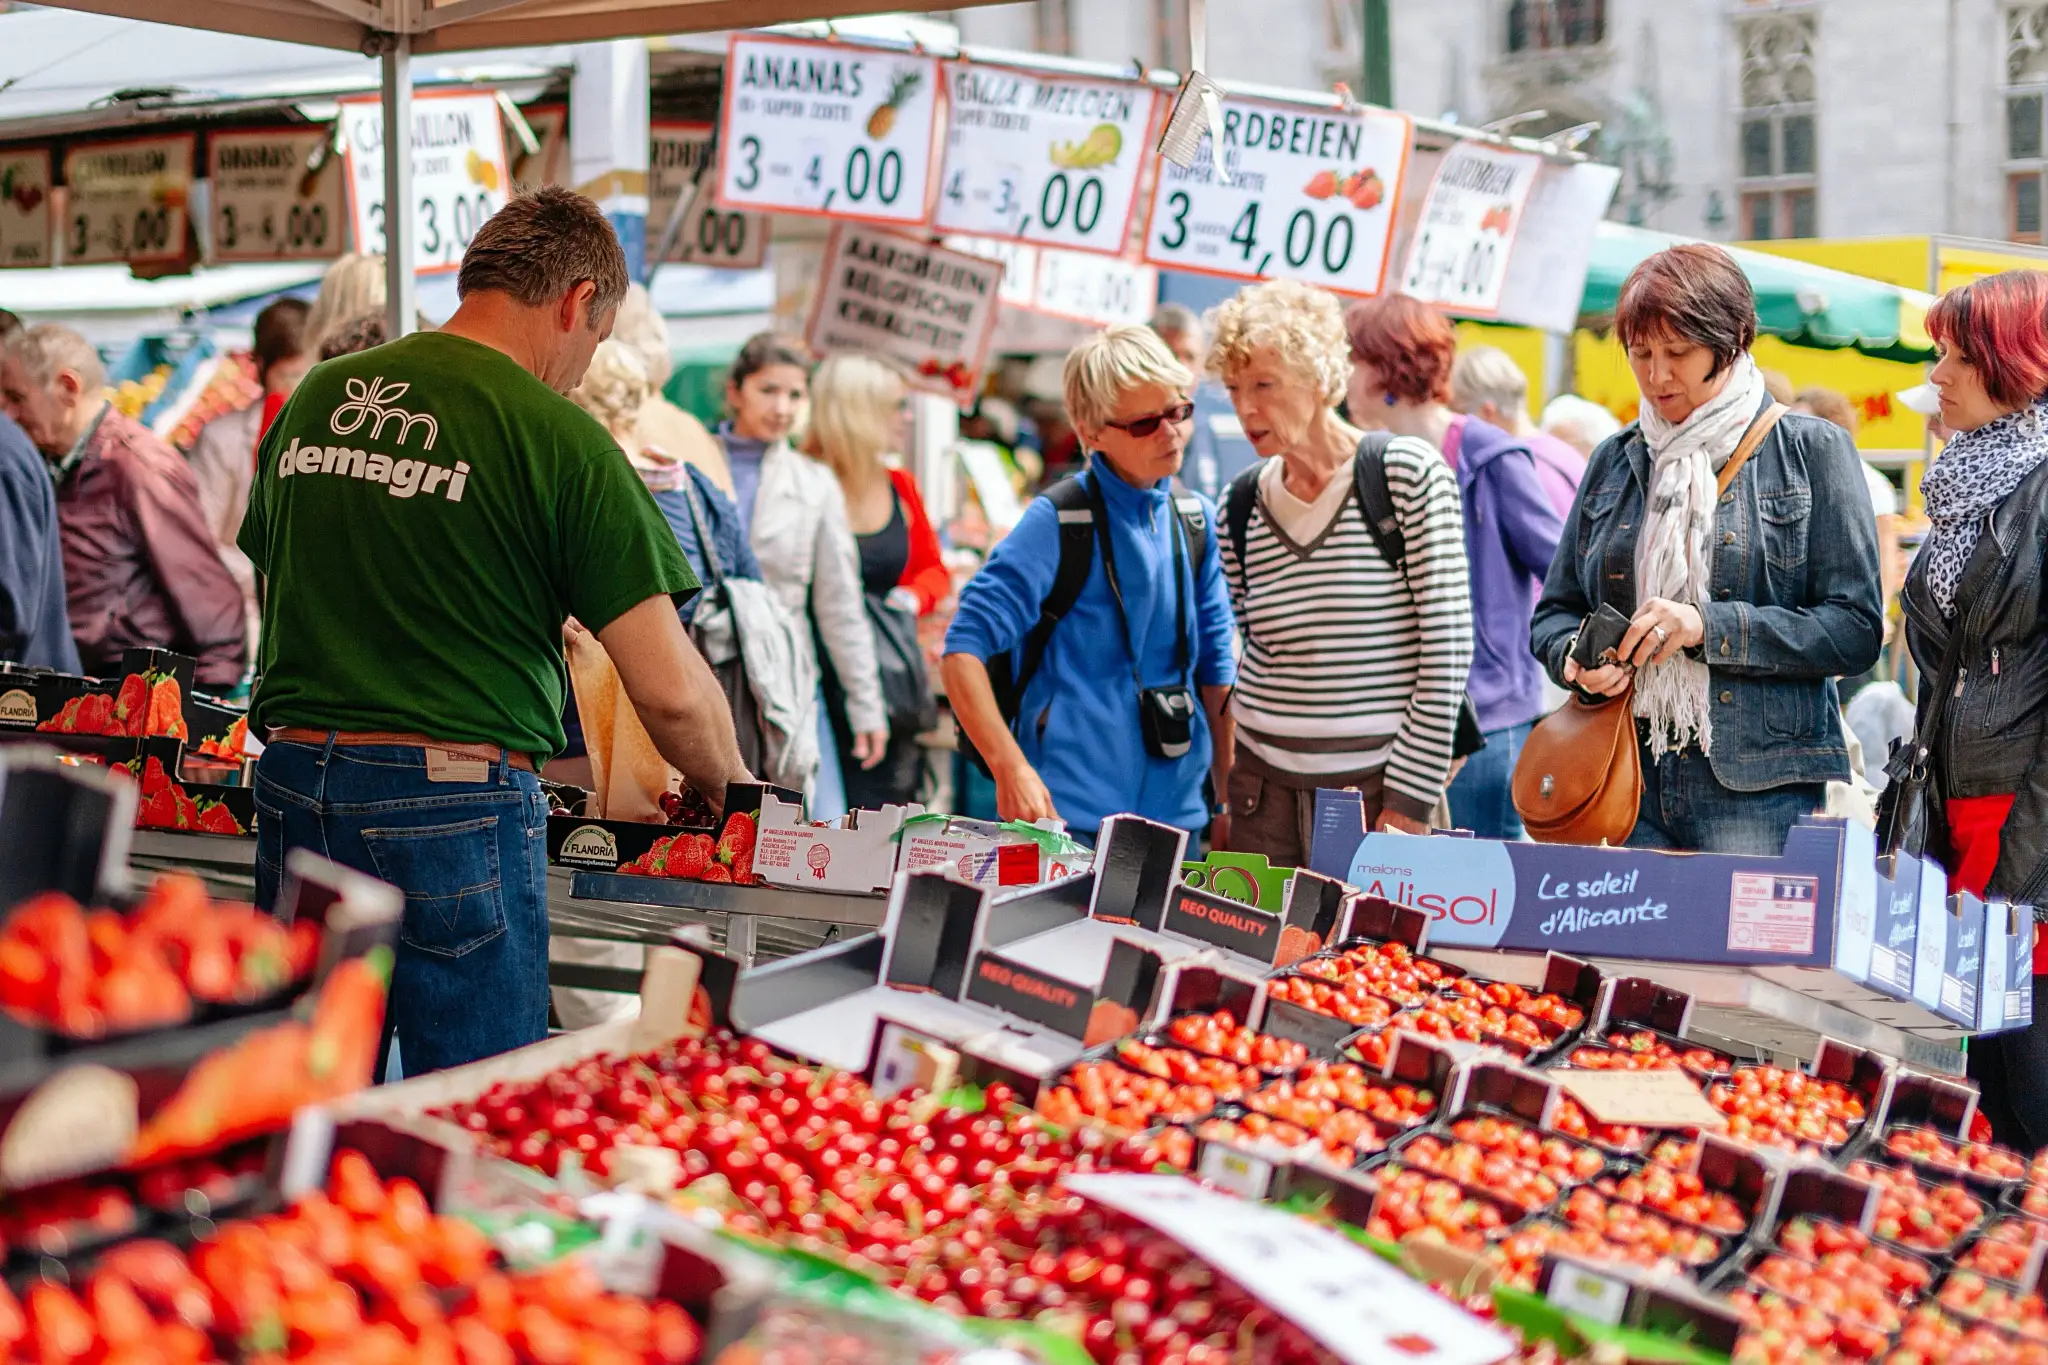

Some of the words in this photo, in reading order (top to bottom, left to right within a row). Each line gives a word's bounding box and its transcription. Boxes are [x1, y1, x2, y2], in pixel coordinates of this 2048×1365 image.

[742, 55, 865, 98] ANANAS
[1203, 109, 1363, 161] RDBEIEN
[736, 133, 762, 191] 3
[805, 145, 904, 210] 4,00
[1160, 190, 1191, 249] 3
[1230, 200, 1354, 277] 4,00
[278, 437, 471, 502] demagri
[0, 706, 35, 718] FLANDRIA
[570, 844, 614, 857] FLANDRIA
[1356, 863, 1413, 877] melons
[1367, 879, 1497, 927] Alisol
[1538, 872, 1571, 900] Le
[1576, 868, 1640, 900] soleil
[1179, 897, 1207, 918] REO
[1208, 908, 1268, 936] QUALITY
[1539, 897, 1669, 936] d'Alicante
[1011, 973, 1077, 1008] QUALITY
